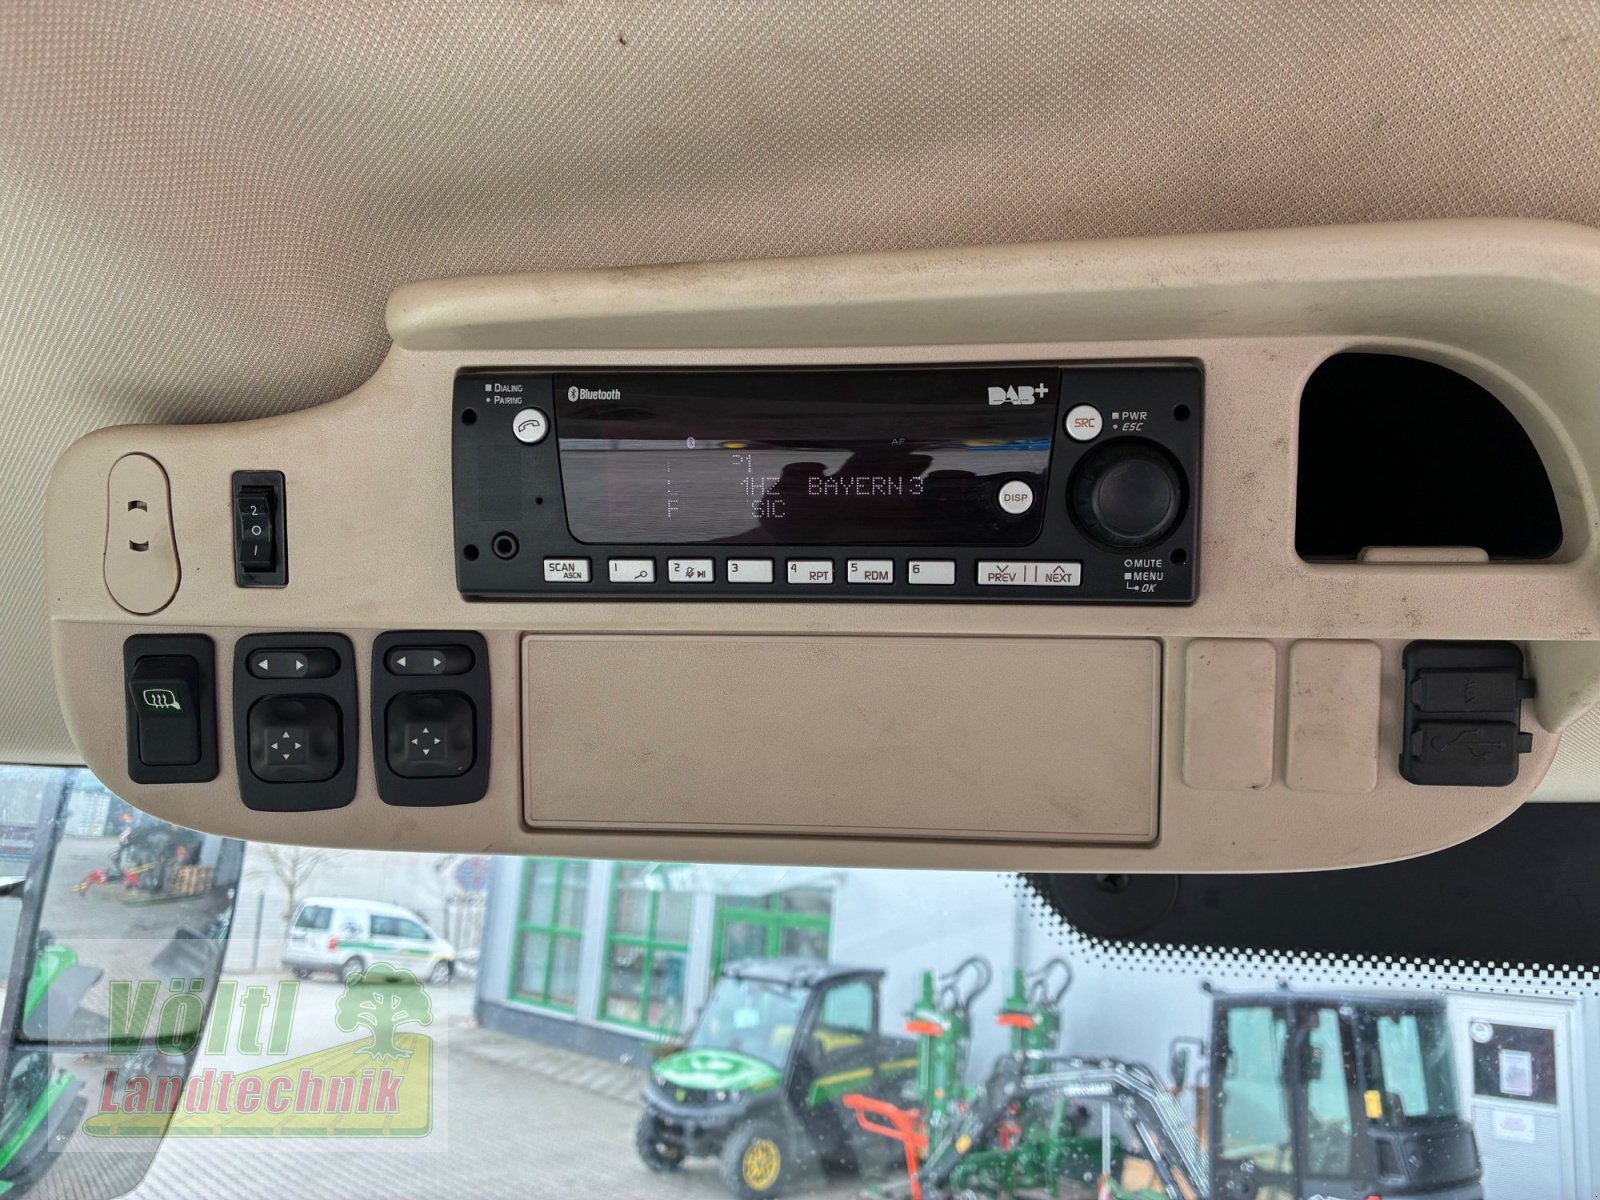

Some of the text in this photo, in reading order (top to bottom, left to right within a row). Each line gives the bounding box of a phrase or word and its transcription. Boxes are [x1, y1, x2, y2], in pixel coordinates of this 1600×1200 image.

[579, 388, 621, 401] Bluetooth
[1121, 411, 1148, 421] PWR
[1074, 417, 1096, 428] SRC
[1121, 422, 1144, 432] ESC
[808, 476, 903, 496] BAYERN
[909, 476, 925, 496] 3
[1003, 493, 1028, 502] DISP
[250, 505, 259, 516] 2
[548, 562, 575, 572] SCAN
[673, 562, 681, 573] 2
[731, 563, 739, 573] 3
[790, 563, 797, 573] 4
[851, 562, 859, 573] 5
[1134, 559, 1163, 568] MUTE
[912, 564, 920, 574] 6
[809, 571, 829, 581] RPT
[864, 571, 889, 581] RDM
[987, 573, 1073, 583] PREV NEXT
[1133, 572, 1164, 581] MENU
[1141, 583, 1157, 593] OK
